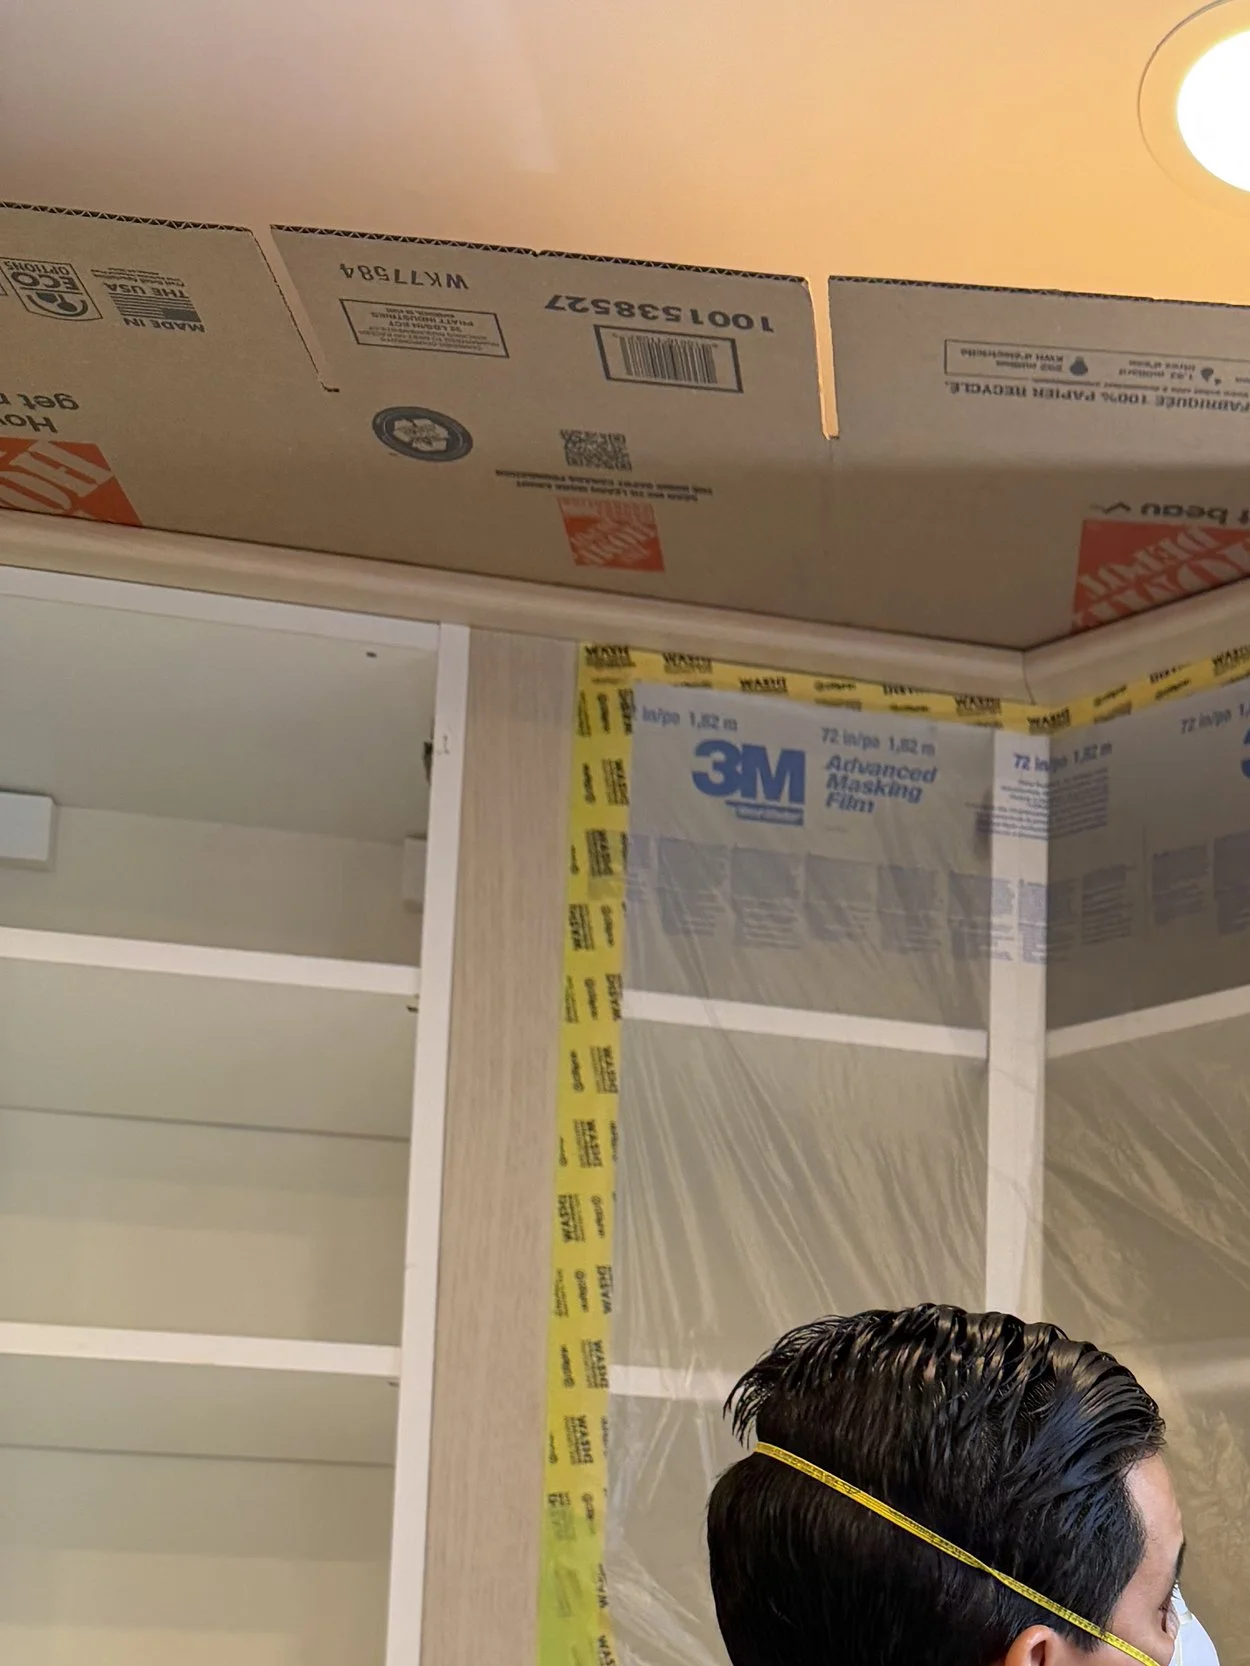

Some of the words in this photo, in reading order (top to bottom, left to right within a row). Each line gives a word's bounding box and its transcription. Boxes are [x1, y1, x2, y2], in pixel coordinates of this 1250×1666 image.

[4, 260, 69, 275] OPTIONS
[11, 272, 80, 290] ECO
[340, 264, 468, 290] WK77584
[104, 282, 143, 296] USA
[147, 286, 187, 299] THE
[124, 318, 145, 328] IN
[544, 294, 774, 334] 1001538527
[152, 319, 205, 333] MADE
[17, 393, 79, 411] get
[1032, 388, 1096, 402] PAPIER
[1100, 392, 1148, 405] 100%
[1141, 503, 1228, 525] beau
[739, 677, 789, 692] WASHI
[821, 727, 840, 745] 72
[692, 739, 806, 806] 3M
[823, 753, 939, 784] Advanced
[825, 774, 923, 804] Masking
[824, 790, 876, 815] Film
